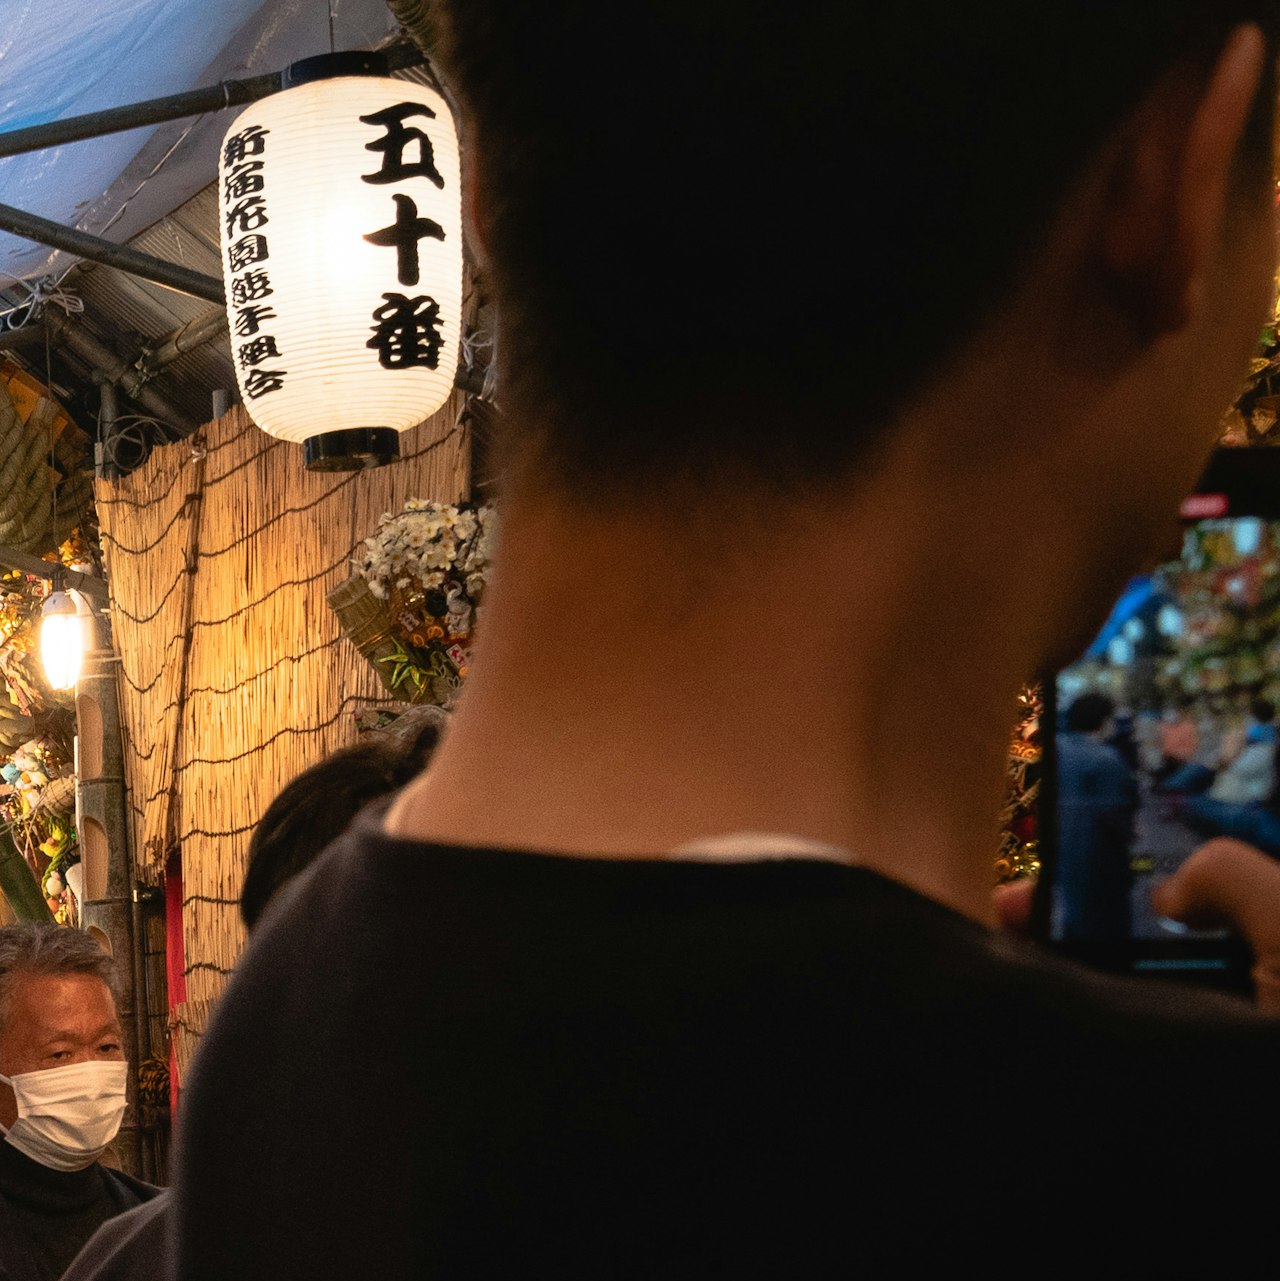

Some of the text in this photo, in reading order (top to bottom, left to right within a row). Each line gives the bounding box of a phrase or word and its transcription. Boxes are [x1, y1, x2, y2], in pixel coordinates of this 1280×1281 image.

[224, 125, 287, 400] 新宿花園熊手組合
[359, 102, 446, 370] 五十番
